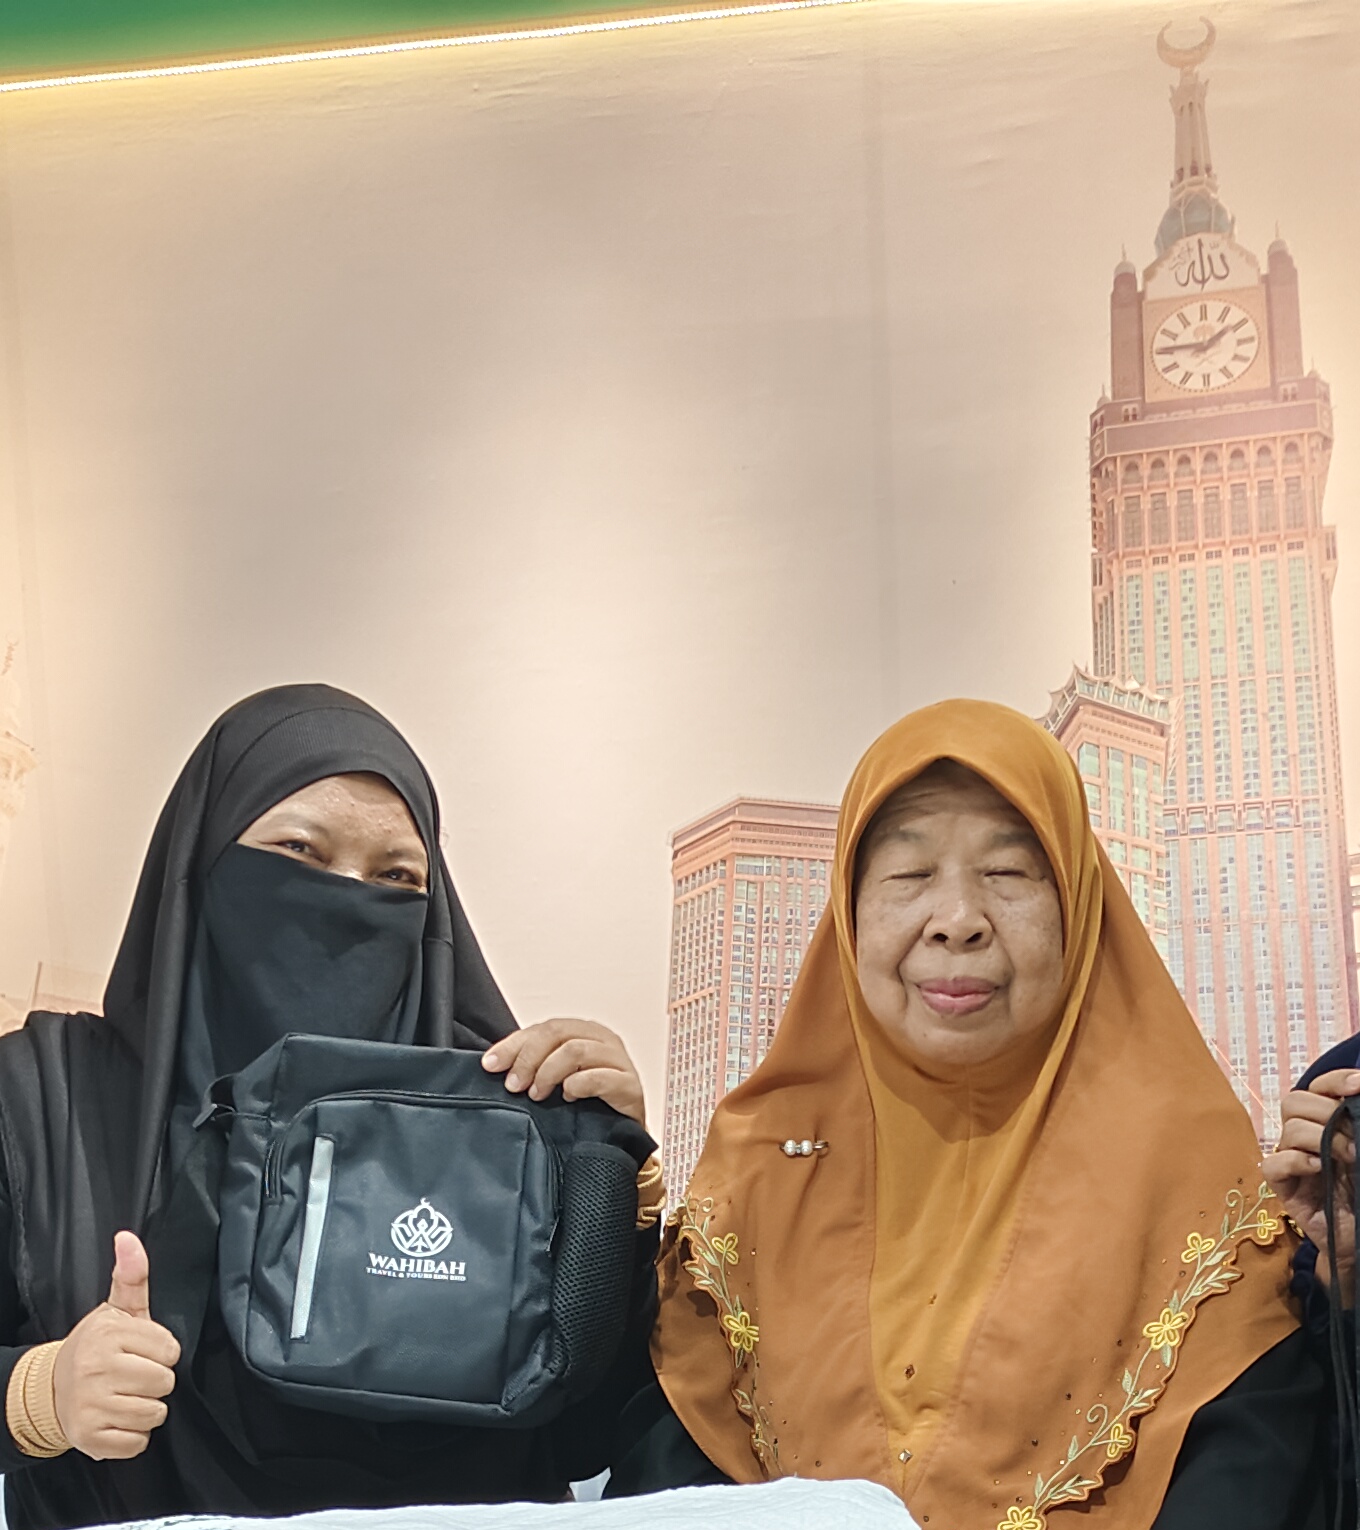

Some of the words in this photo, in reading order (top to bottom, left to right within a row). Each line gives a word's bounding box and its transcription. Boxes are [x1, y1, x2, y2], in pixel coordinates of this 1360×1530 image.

[368, 1252, 466, 1275] WAHIBAH
[366, 1267, 397, 1278] TRAVEL
[406, 1272, 433, 1280] TOURS
